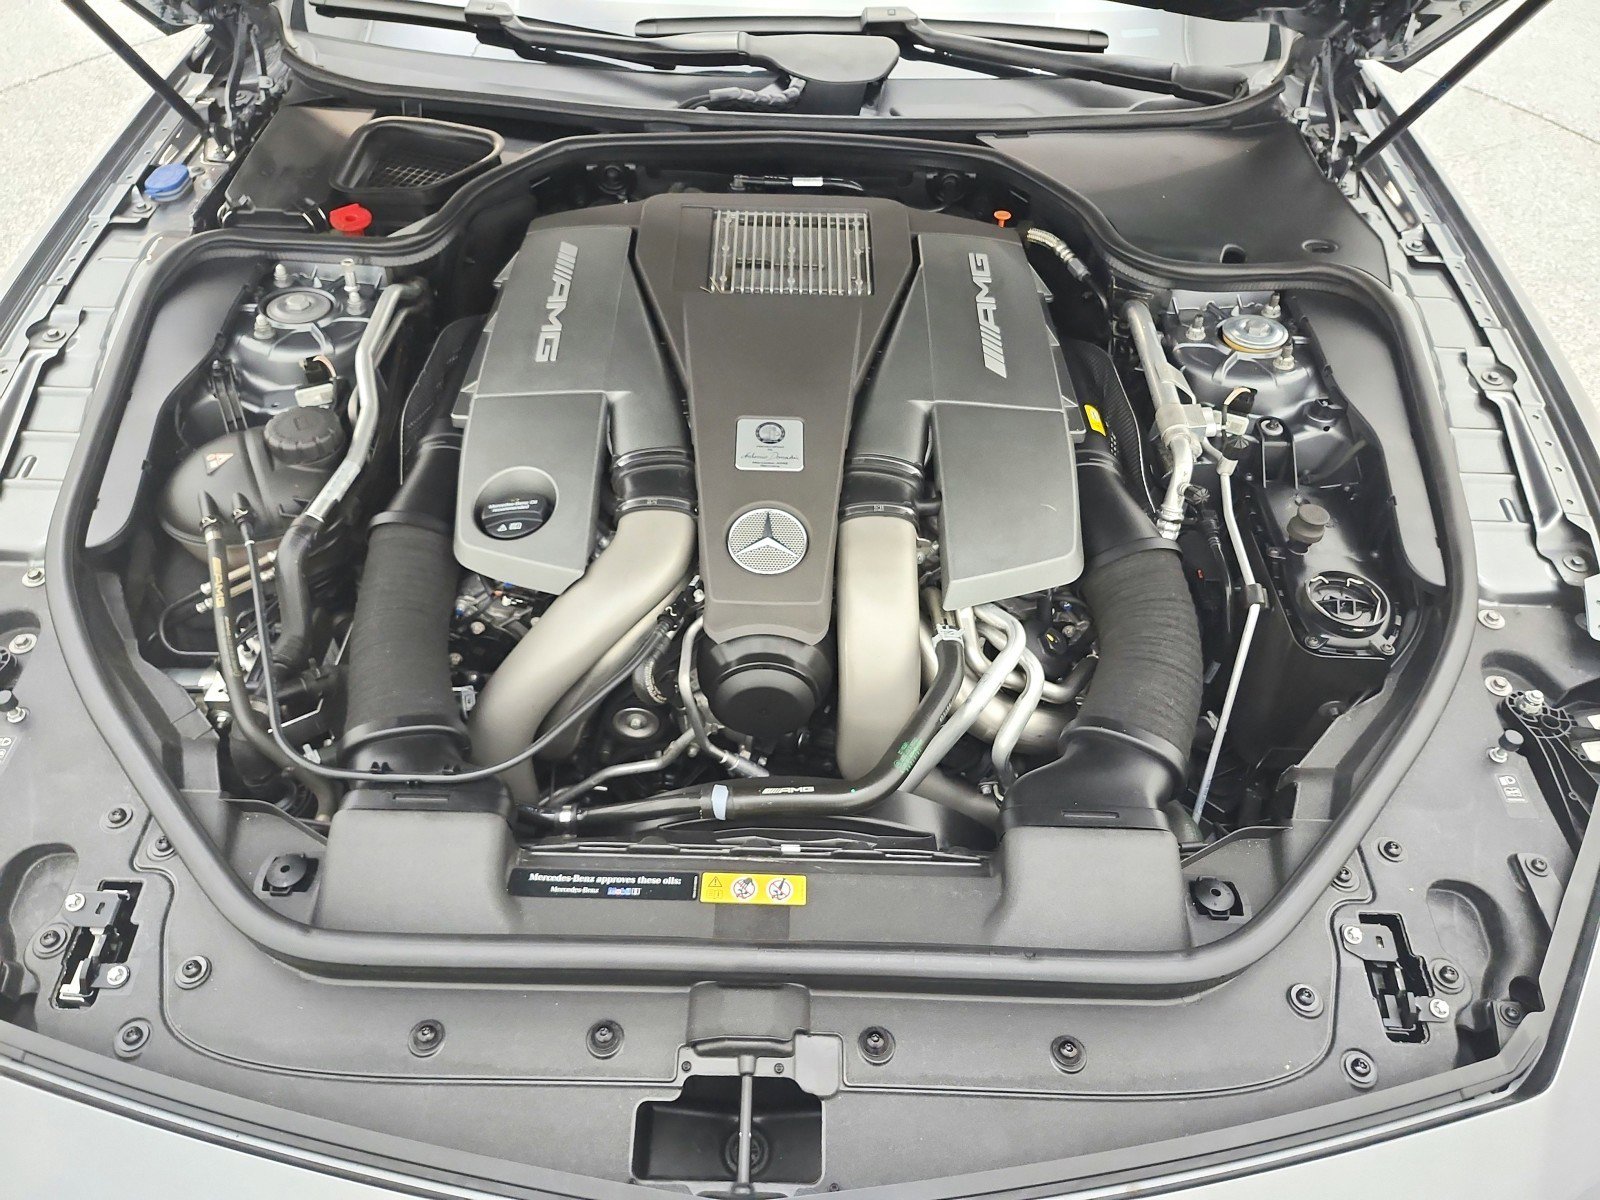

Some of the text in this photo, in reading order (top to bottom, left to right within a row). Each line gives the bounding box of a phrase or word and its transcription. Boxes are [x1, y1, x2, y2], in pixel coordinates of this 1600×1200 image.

[535, 273, 572, 362] AMG
[528, 873, 682, 885] Mercedes-Benz approves these oils:
[550, 886, 599, 894] Mercedes-Benz
